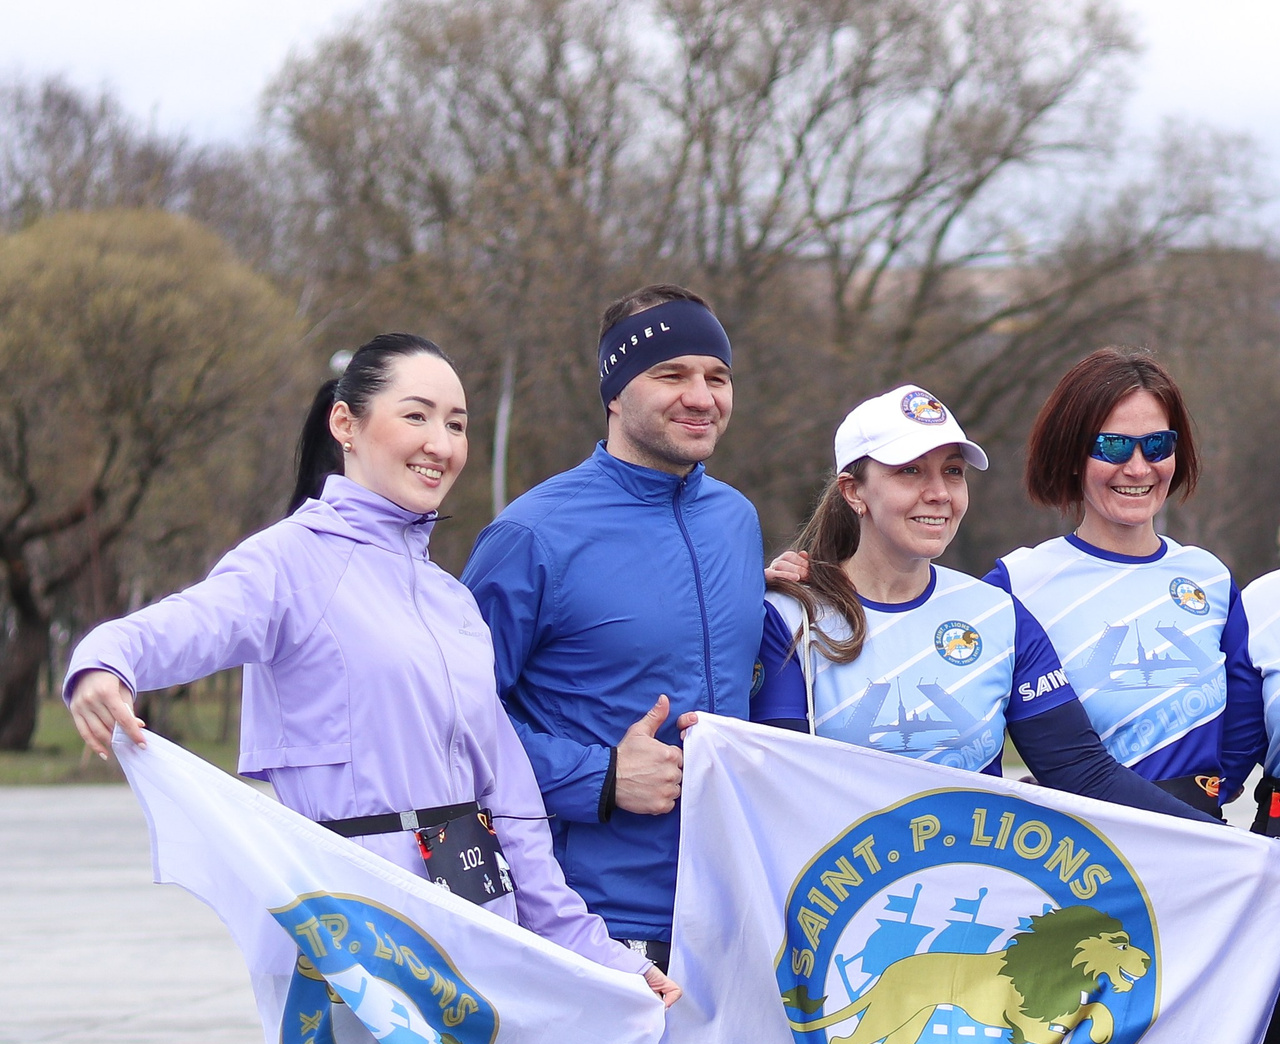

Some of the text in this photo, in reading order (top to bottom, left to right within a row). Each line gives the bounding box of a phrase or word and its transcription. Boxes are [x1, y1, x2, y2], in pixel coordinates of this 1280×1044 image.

[459, 846, 485, 871] 102
[970, 807, 1112, 900] LIONS
[365, 920, 479, 1028] LIONS
